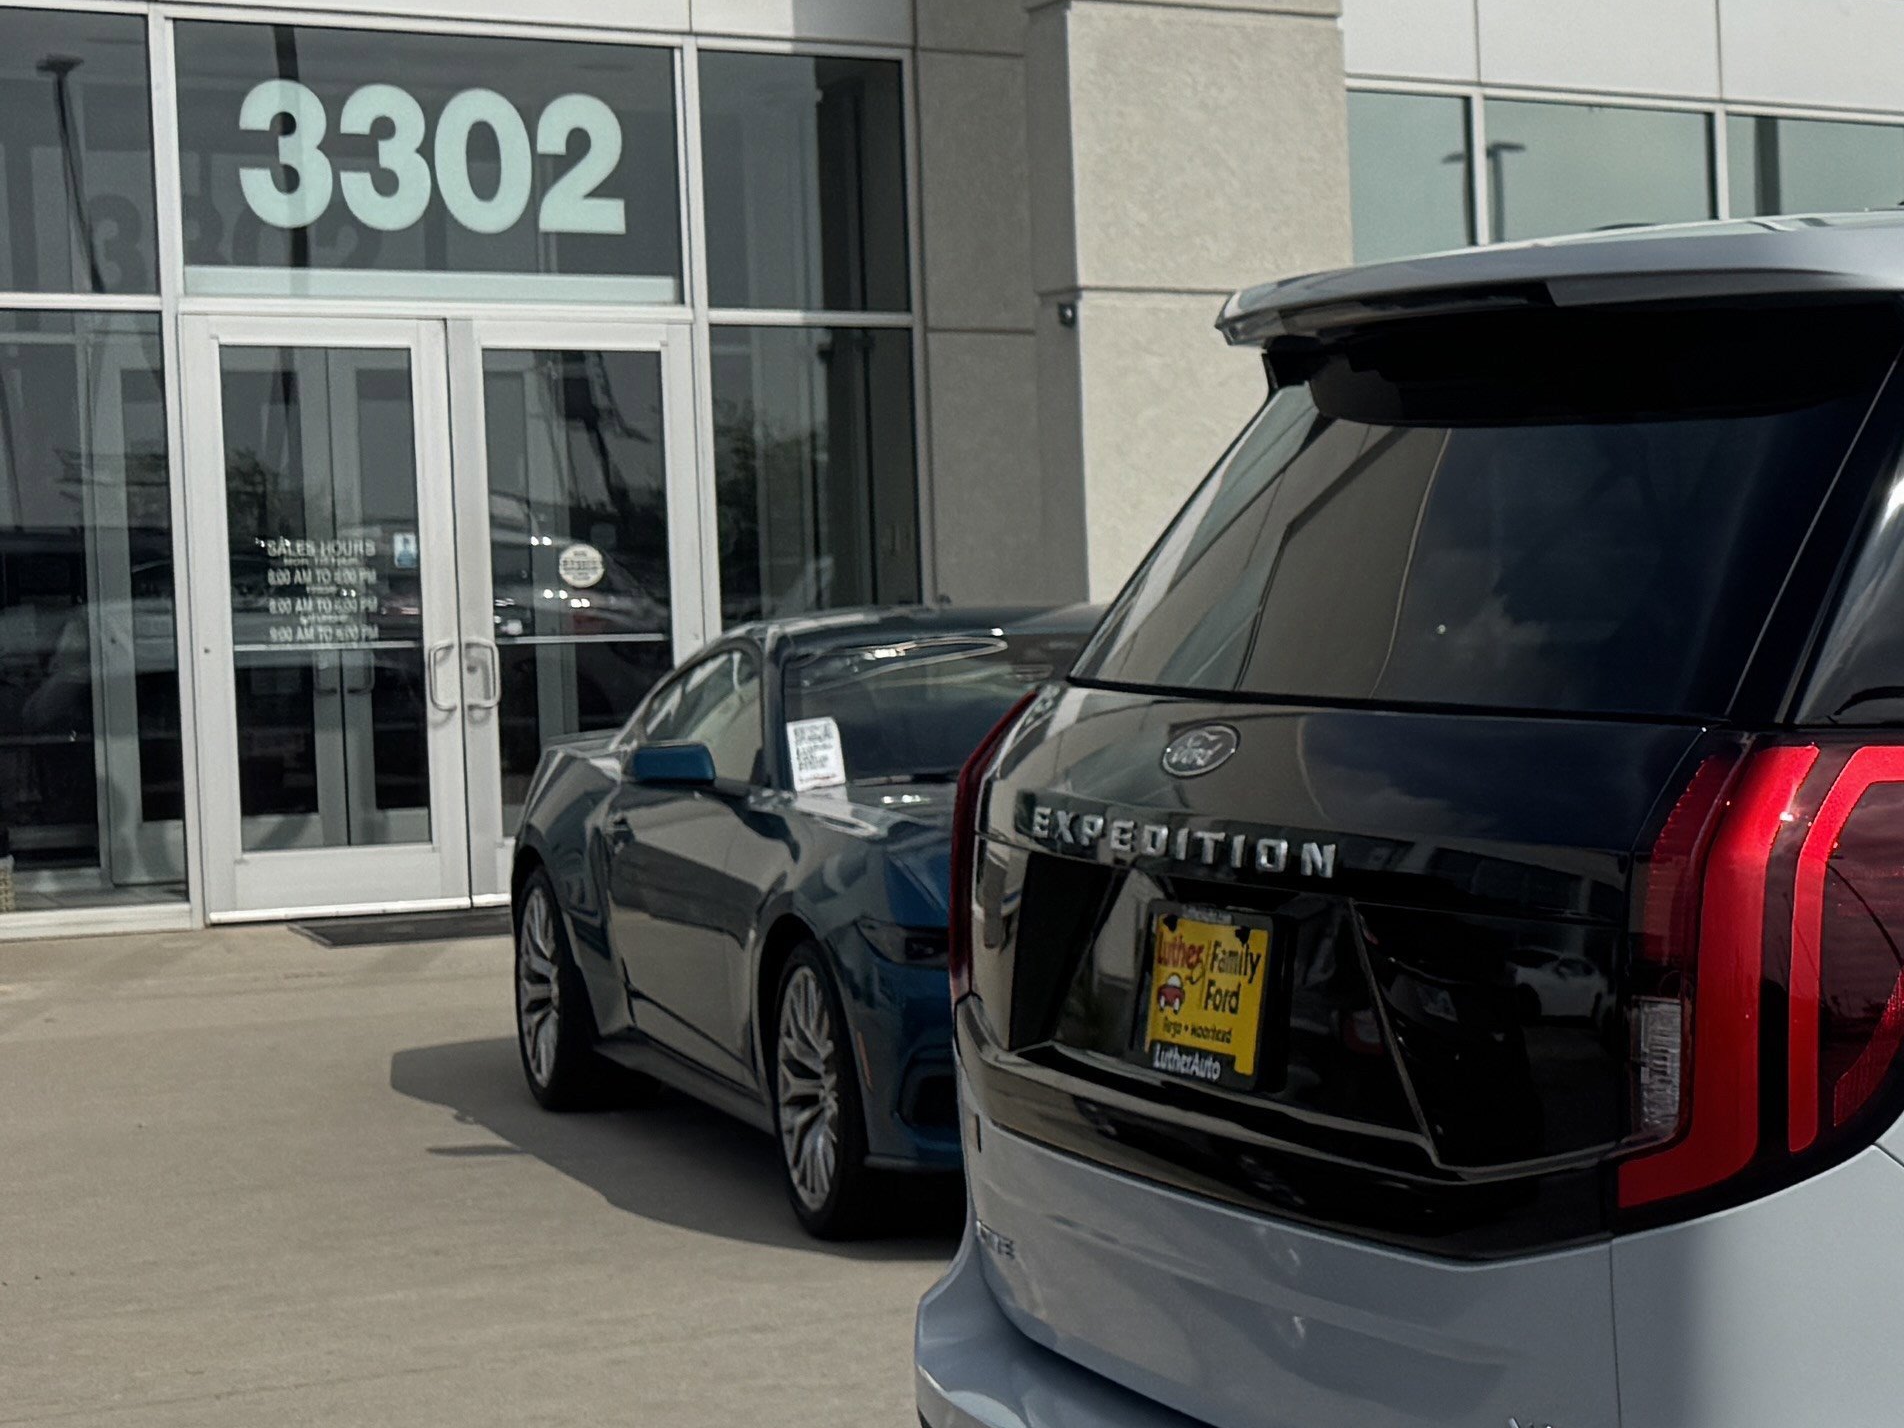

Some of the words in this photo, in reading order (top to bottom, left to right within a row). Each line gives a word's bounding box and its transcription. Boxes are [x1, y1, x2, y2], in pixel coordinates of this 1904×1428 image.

[239, 78, 627, 235] 3302
[267, 538, 316, 557] SALES
[319, 538, 377, 557] HOURS
[1032, 806, 1337, 879] EXPEDITION
[1209, 939, 1262, 985] Family
[1203, 978, 1242, 1015] Ford
